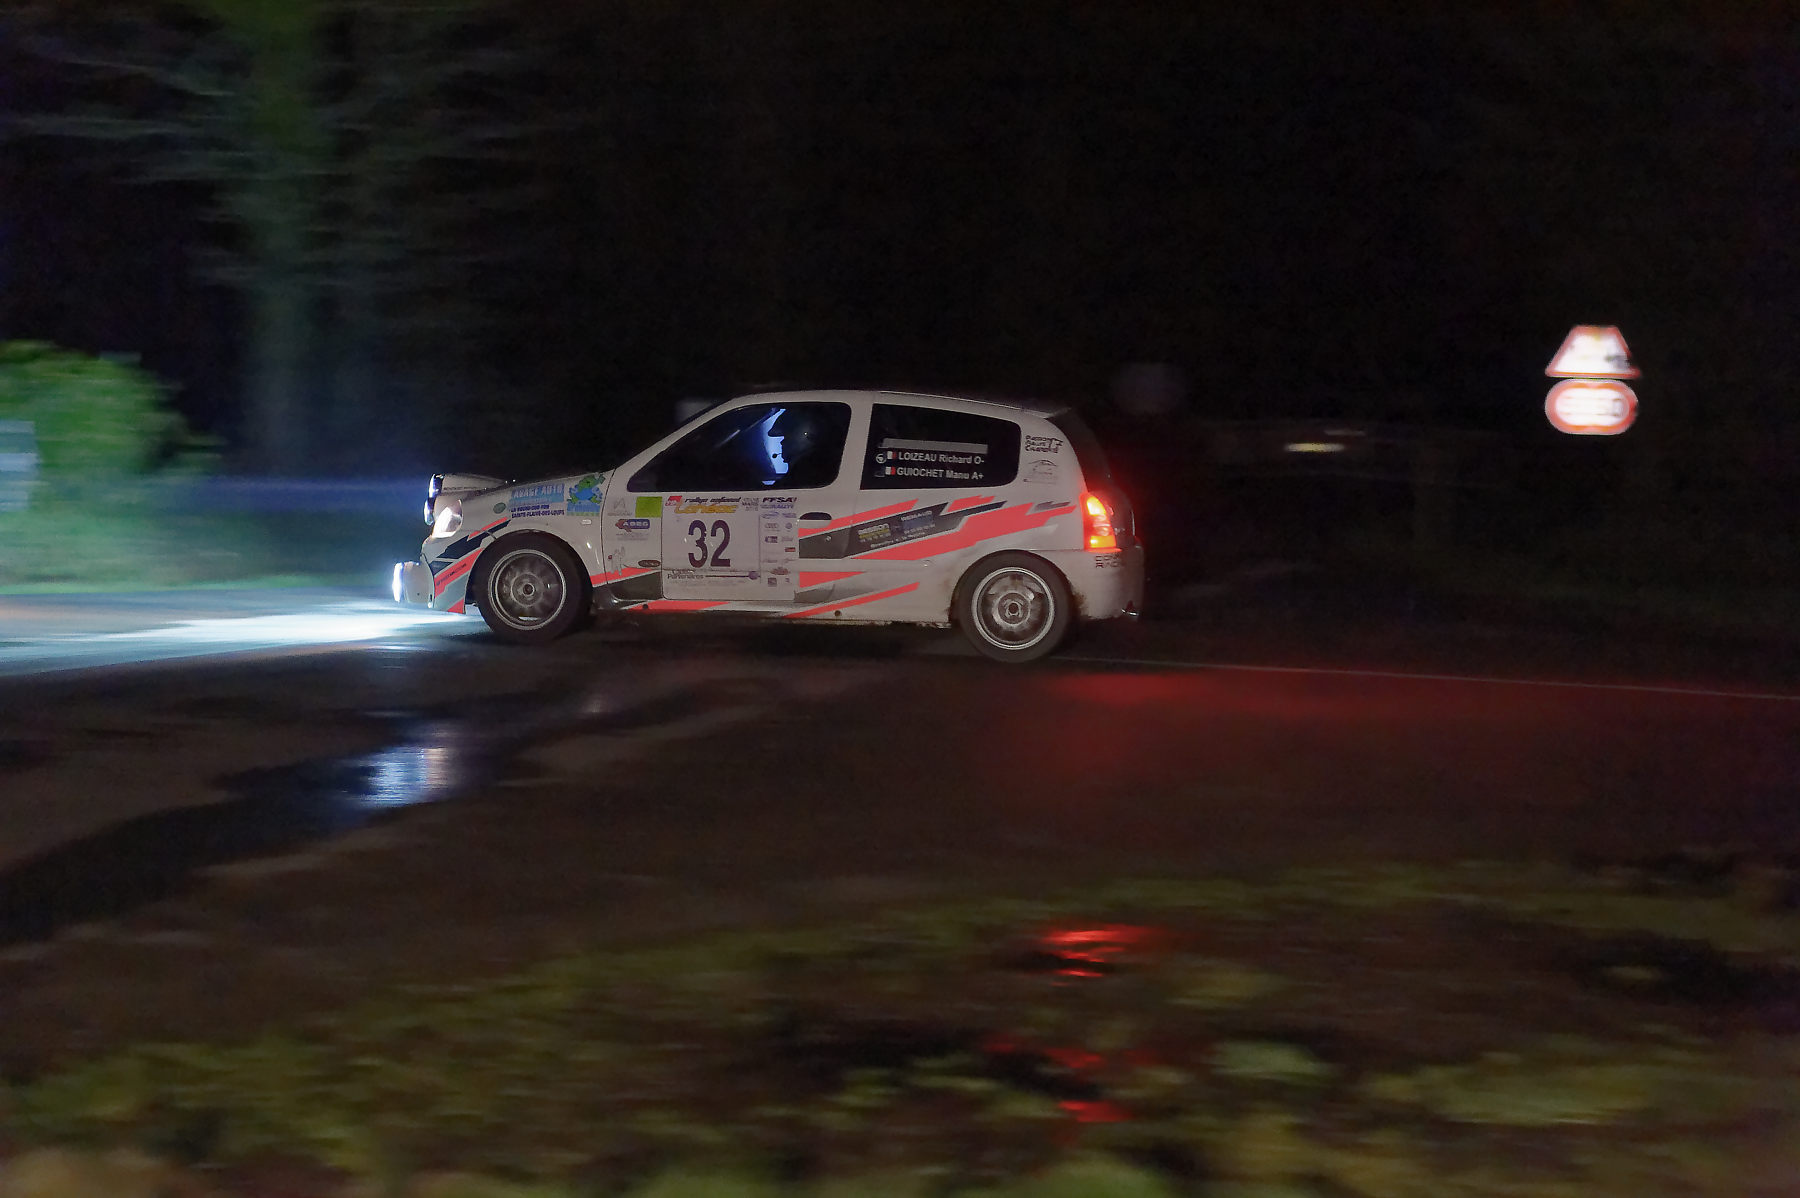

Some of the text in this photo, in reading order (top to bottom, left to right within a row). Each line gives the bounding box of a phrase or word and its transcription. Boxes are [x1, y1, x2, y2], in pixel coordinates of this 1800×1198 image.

[898, 451, 937, 463] LOIZEAU
[938, 454, 973, 464] Richard
[896, 467, 984, 480] GUIOCHET Manu A+
[687, 519, 731, 568] 32
